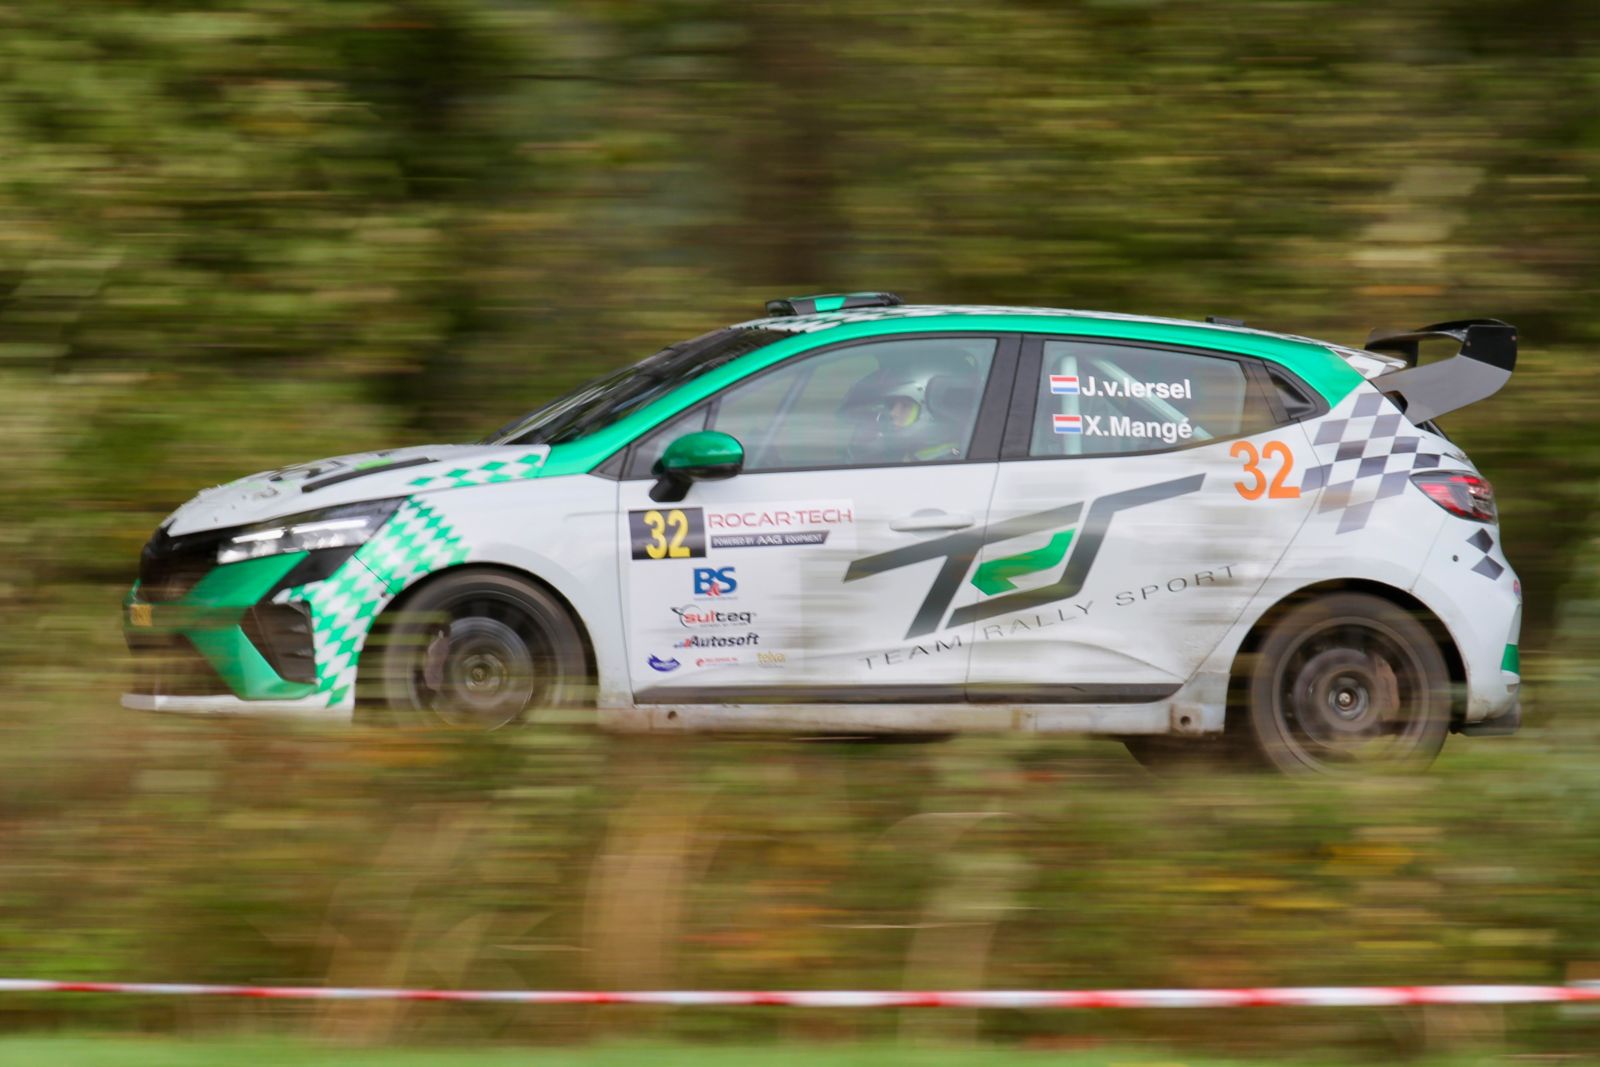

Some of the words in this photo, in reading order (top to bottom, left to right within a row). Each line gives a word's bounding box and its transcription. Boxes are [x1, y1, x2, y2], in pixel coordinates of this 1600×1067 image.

[1084, 415, 1193, 443] X.Mangé
[1229, 440, 1302, 501] 32
[643, 509, 691, 559] 32
[690, 632, 759, 648] Autosoft
[858, 634, 963, 670] TEAM
[983, 601, 1094, 641] RALLY
[1115, 563, 1238, 607] SPORT
